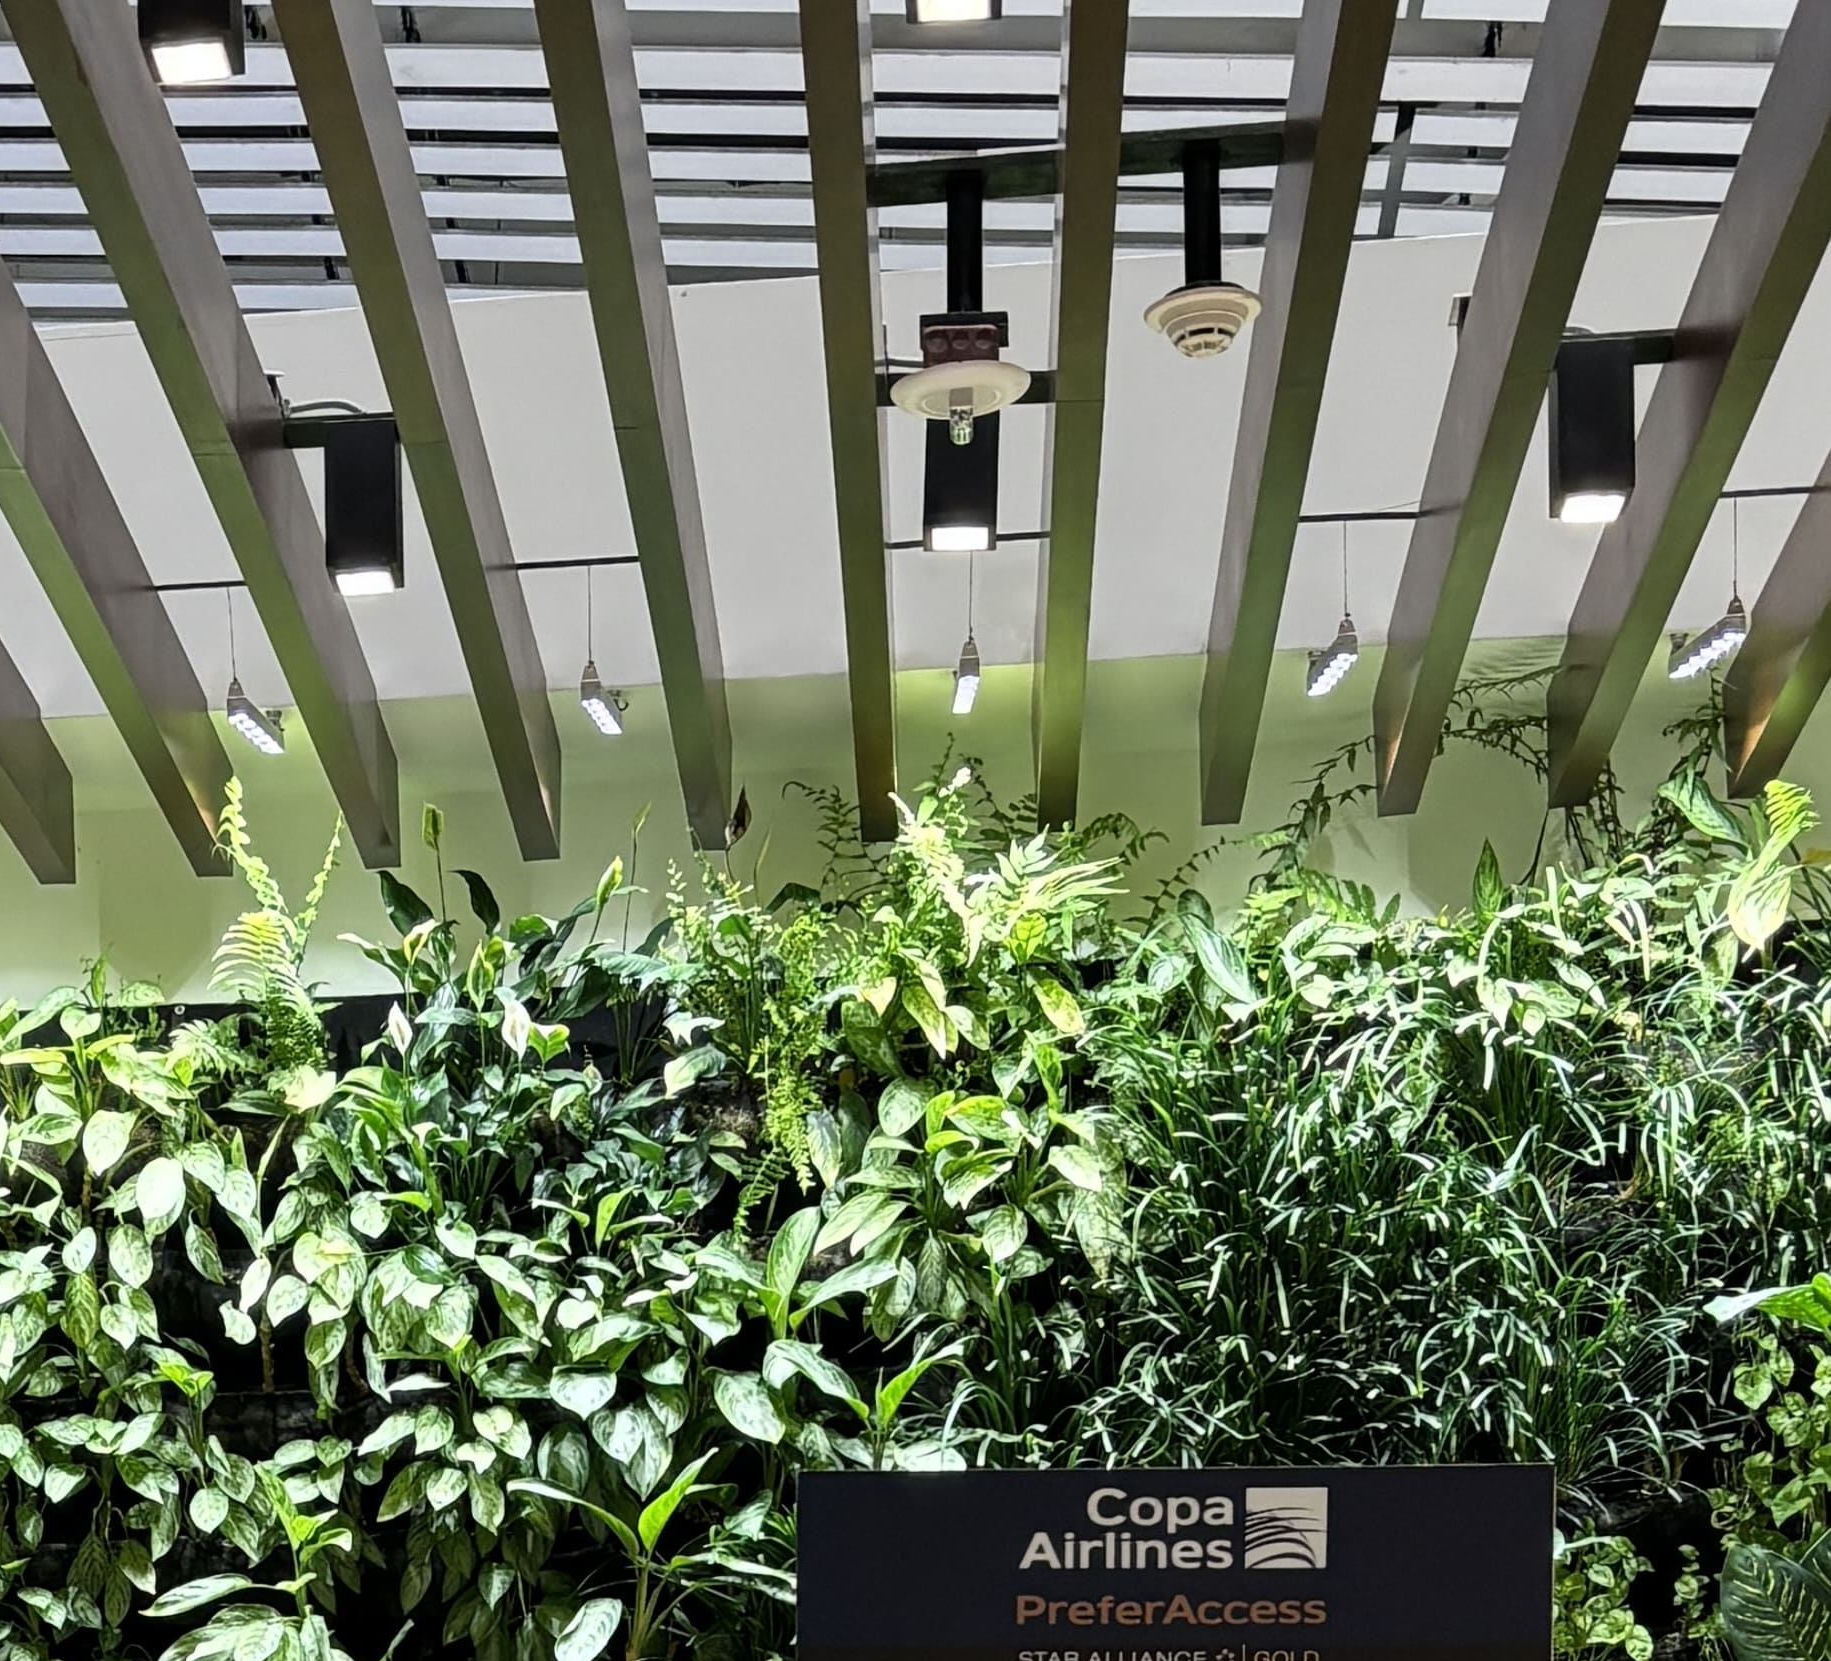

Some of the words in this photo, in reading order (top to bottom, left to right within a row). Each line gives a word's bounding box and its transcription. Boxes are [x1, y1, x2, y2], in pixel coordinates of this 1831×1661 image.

[1087, 1487, 1234, 1534] Copa
[1019, 1532, 1234, 1569] Airlines
[1015, 1594, 1327, 1625] PreferAccess
